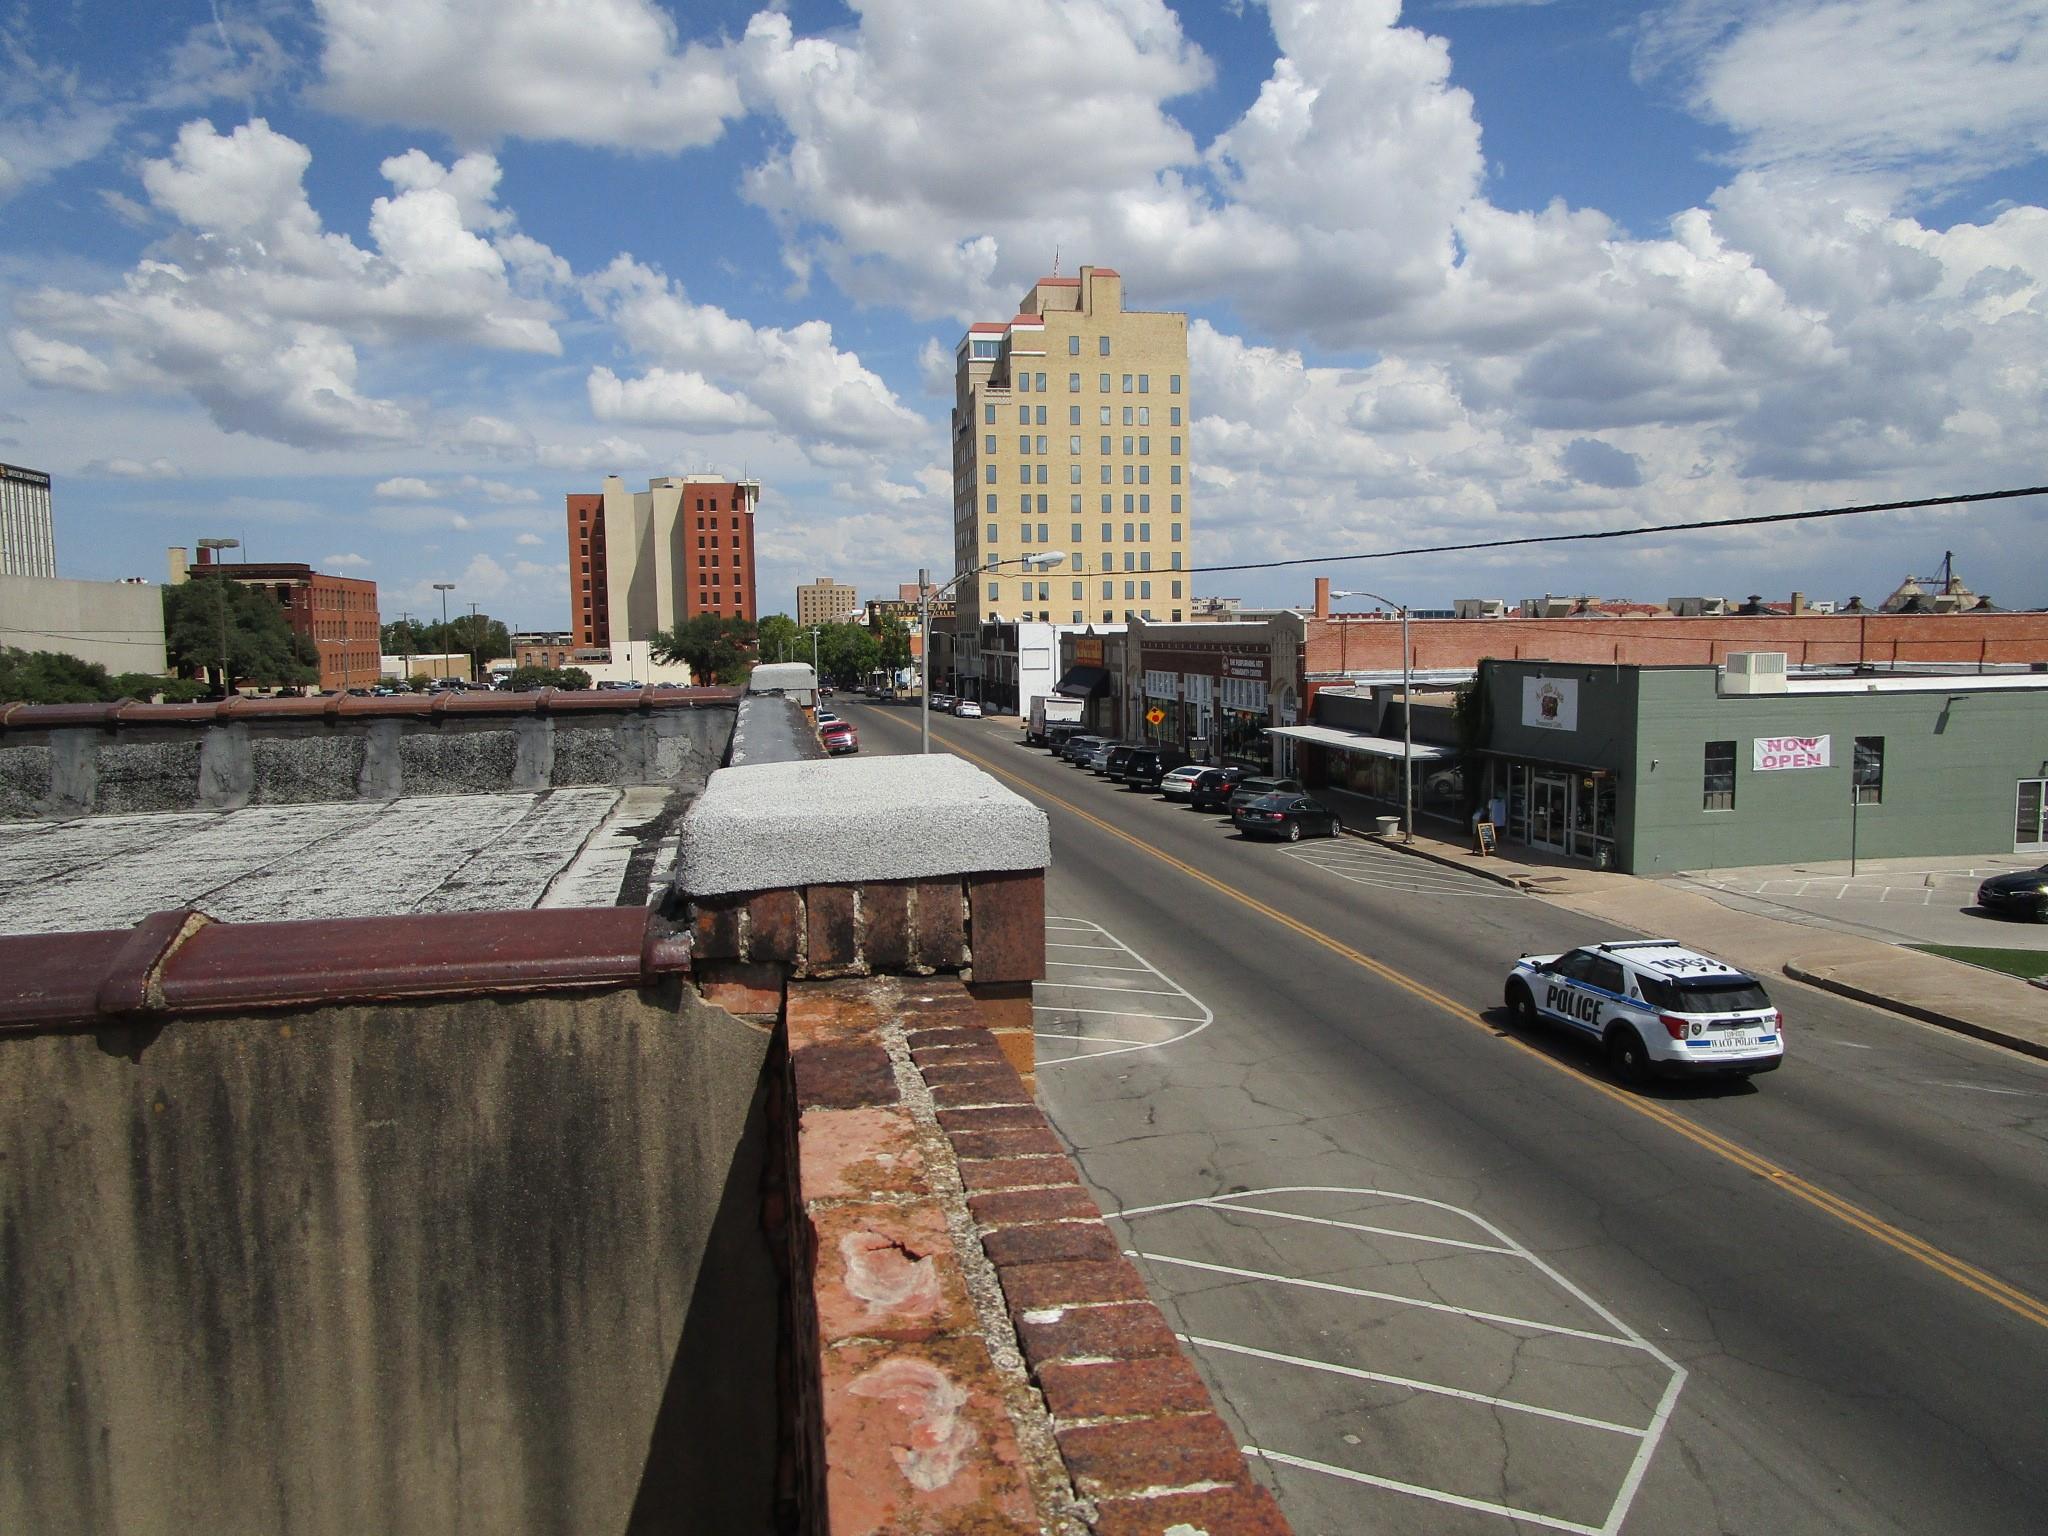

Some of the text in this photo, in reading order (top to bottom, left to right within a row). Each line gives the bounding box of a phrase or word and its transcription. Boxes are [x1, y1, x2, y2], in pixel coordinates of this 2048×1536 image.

[887, 602, 948, 611] ANTEM
[1767, 738, 1818, 752] NOW
[1762, 753, 1822, 768] OPEN
[1546, 984, 1604, 1026] POLICE
[1711, 1037, 1760, 1048] WACO POLICE
